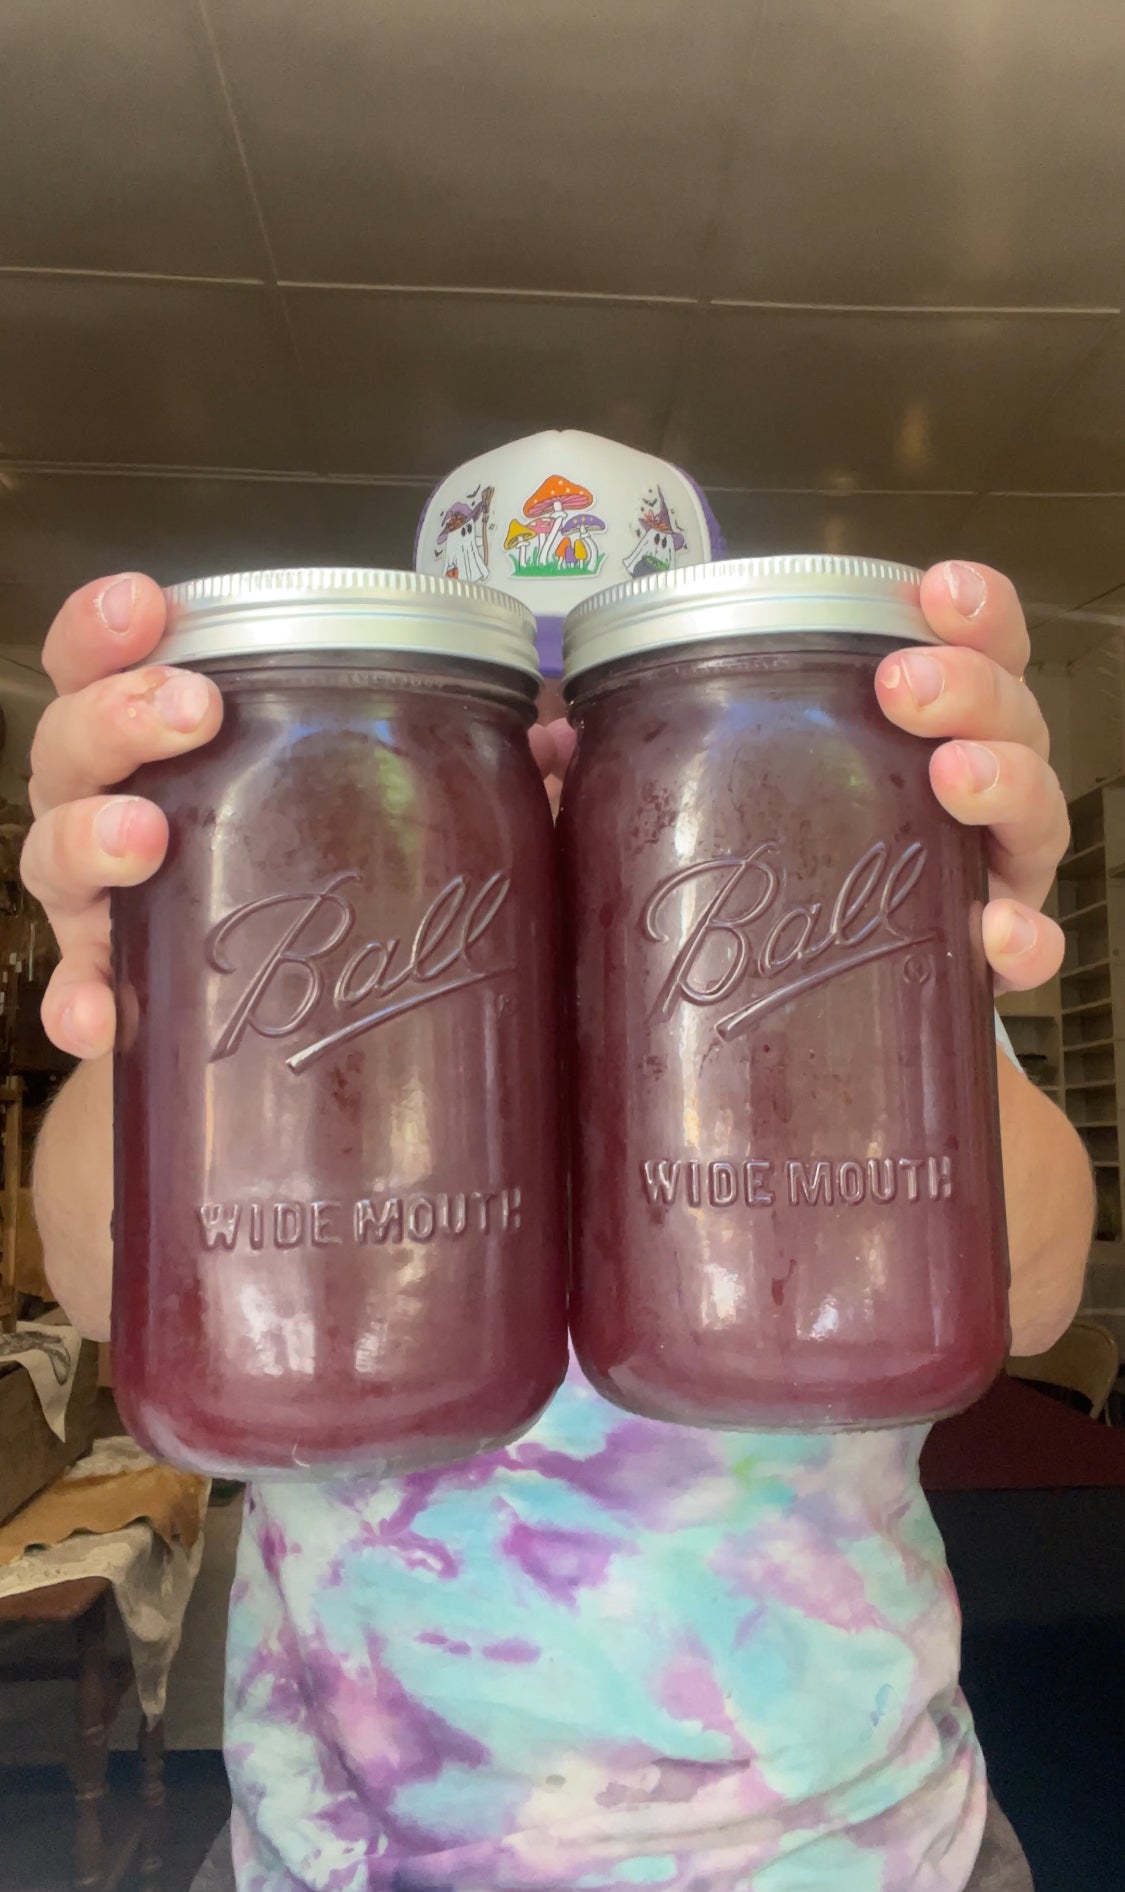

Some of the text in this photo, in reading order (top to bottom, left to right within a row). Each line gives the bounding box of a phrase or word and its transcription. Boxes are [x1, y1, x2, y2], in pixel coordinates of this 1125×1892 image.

[207, 871, 512, 1064] Ball
[638, 841, 927, 1027] Ball
[198, 1188, 522, 1252] WIDE MOUTH
[641, 1155, 952, 1208] WIDE MOUTH
